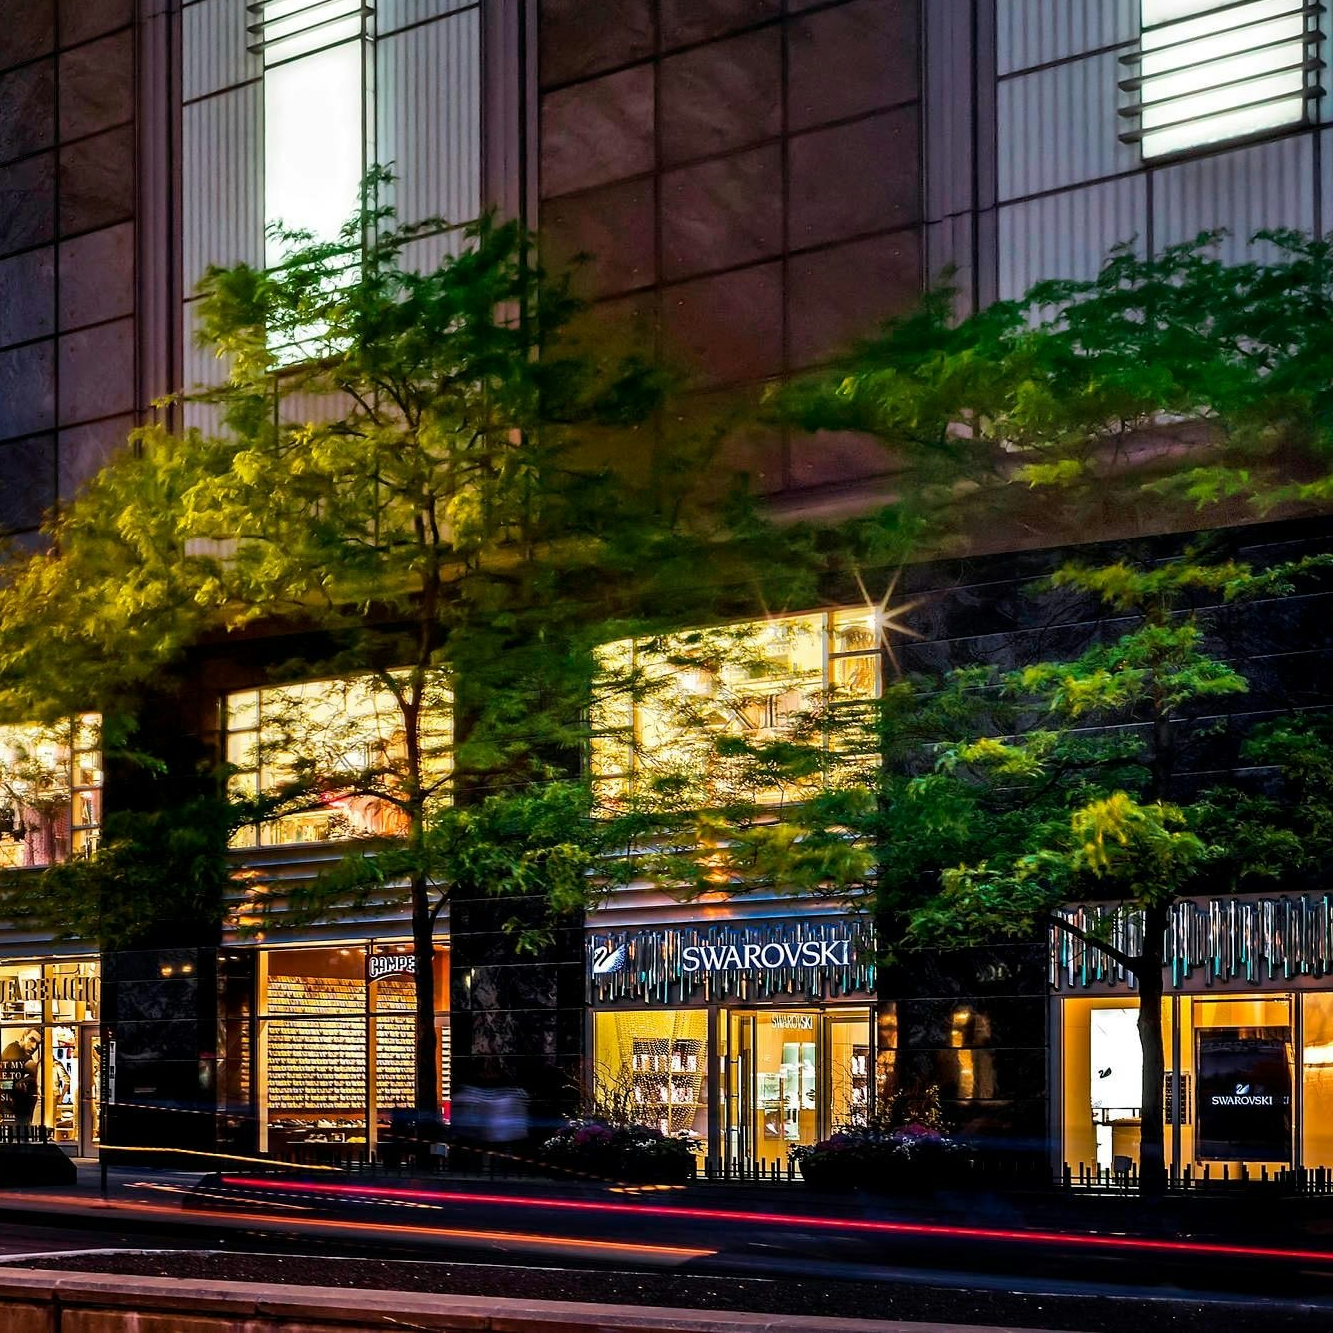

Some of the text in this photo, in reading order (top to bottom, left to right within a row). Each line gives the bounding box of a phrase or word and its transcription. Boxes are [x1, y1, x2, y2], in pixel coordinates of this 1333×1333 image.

[369, 955, 416, 978] CAMPE
[682, 940, 850, 972] SWAROVSKI
[23, 975, 101, 1004] RELIGIO
[771, 1016, 814, 1030] SWAROVSKI
[1211, 1096, 1273, 1106] SWAROVSKI
